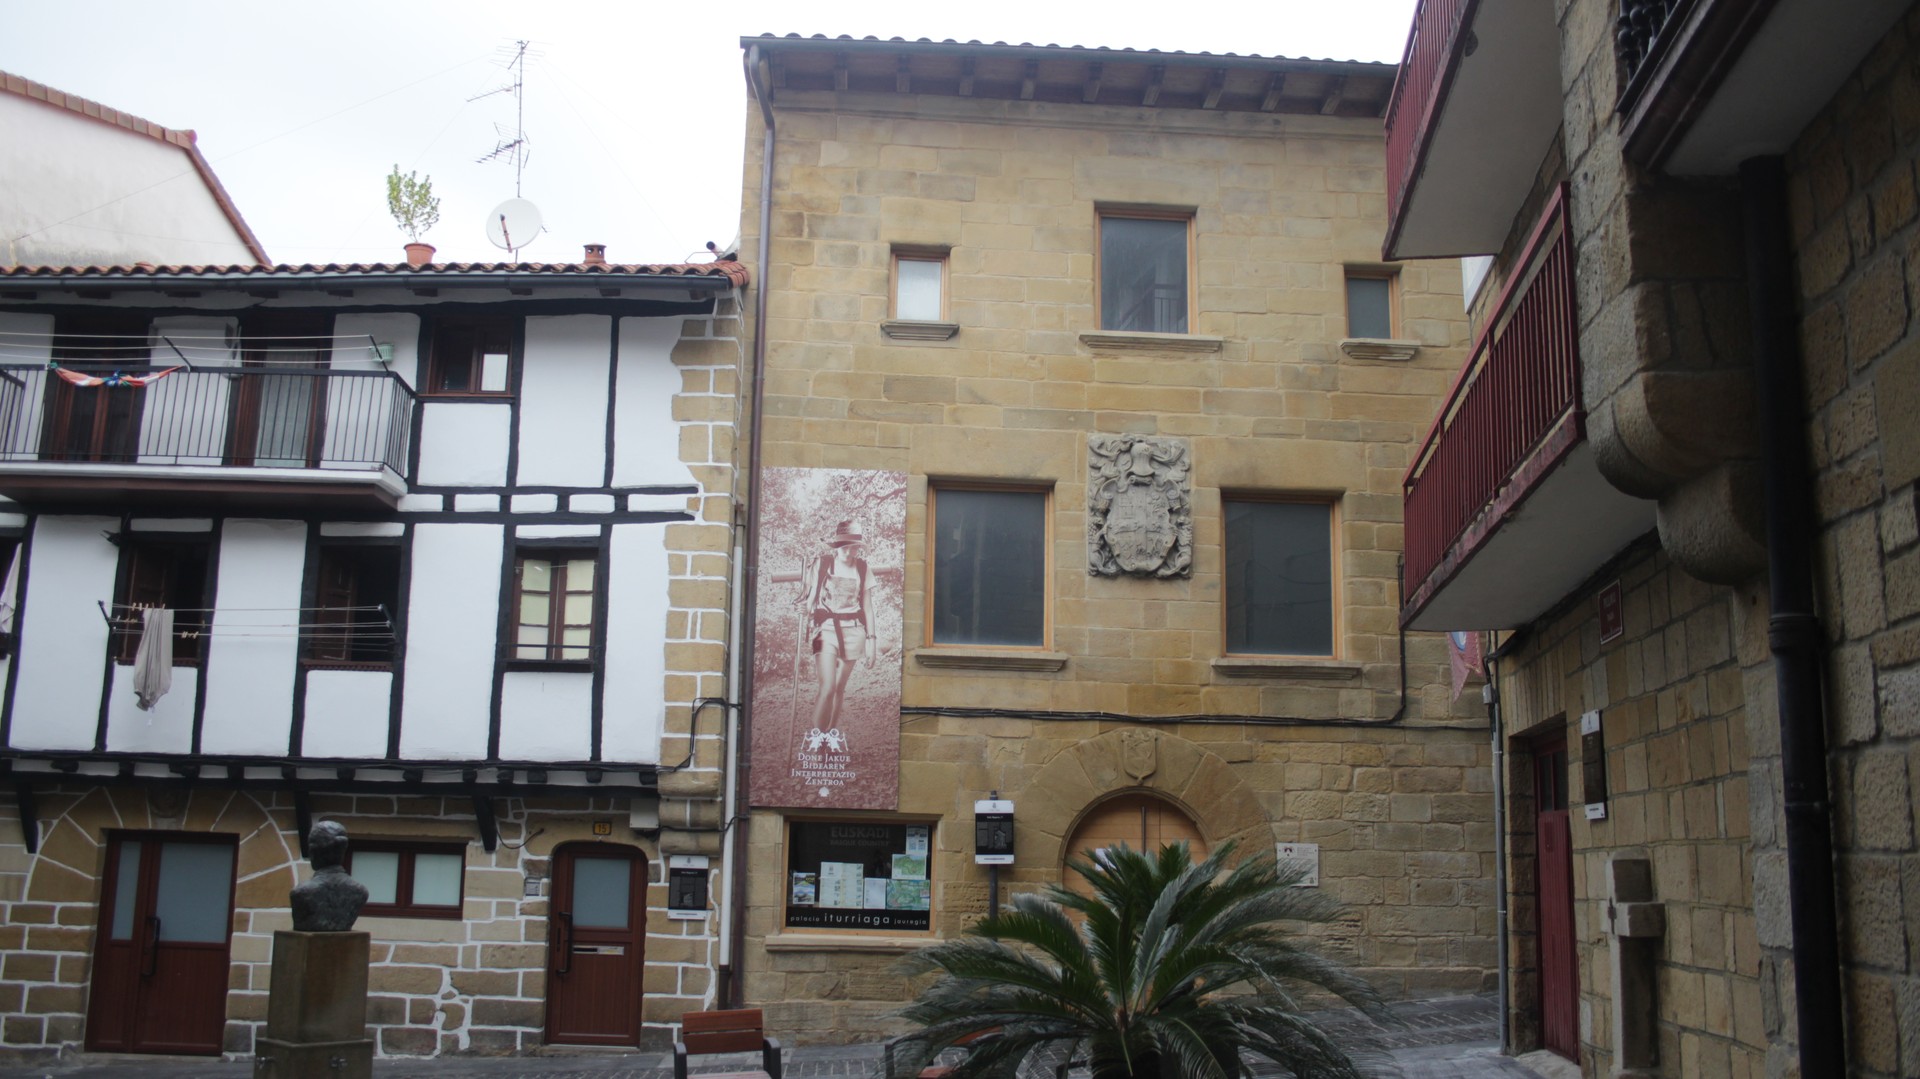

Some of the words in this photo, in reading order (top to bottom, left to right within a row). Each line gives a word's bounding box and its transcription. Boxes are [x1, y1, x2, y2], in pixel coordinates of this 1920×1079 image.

[798, 753, 822, 762] DONE
[825, 754, 851, 763] JAKUE
[803, 761, 845, 770] BIDEAREN
[791, 769, 856, 779] INTERPRETAZIO
[805, 777, 844, 786] ZENTROA
[598, 823, 607, 833] 15
[831, 826, 889, 839] EUSKADI
[824, 913, 890, 926] iturriaga
[894, 917, 927, 926] jauregia
